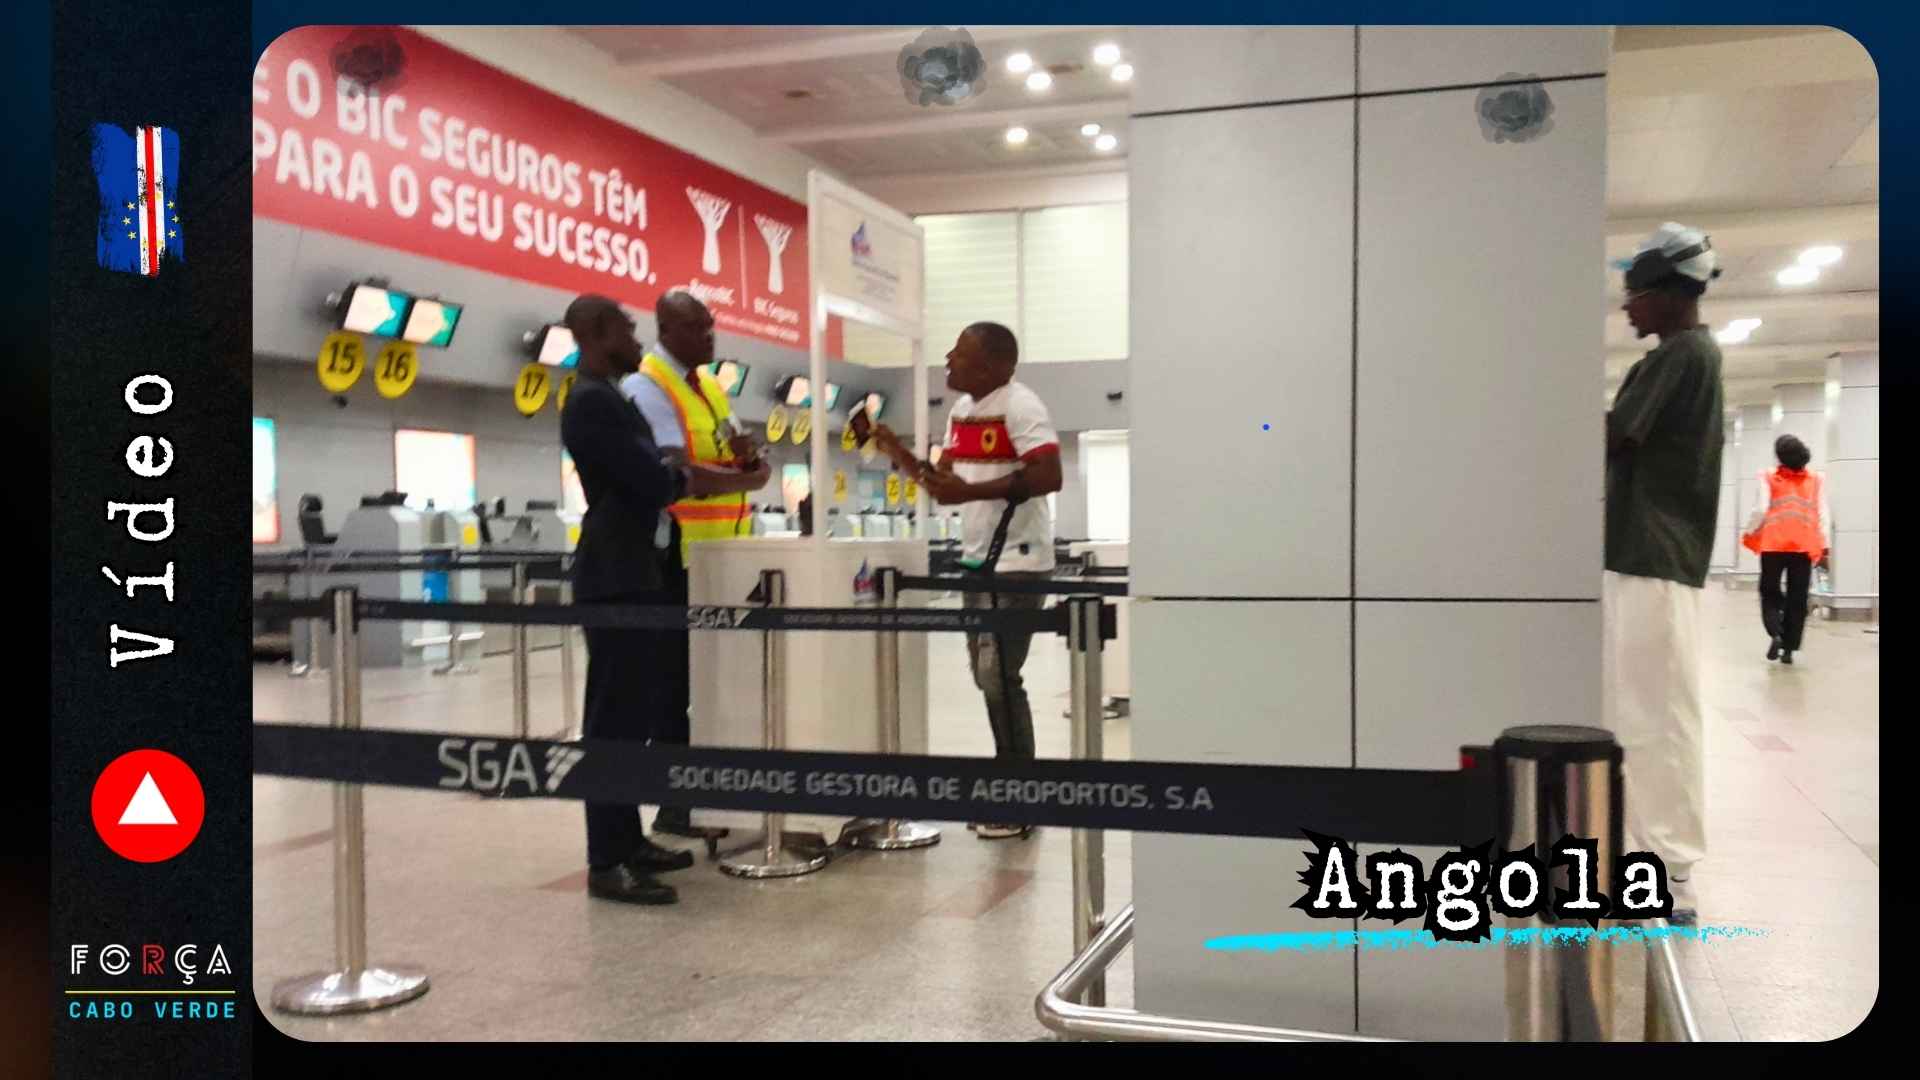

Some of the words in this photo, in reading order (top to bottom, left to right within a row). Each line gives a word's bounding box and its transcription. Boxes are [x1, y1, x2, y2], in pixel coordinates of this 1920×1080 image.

[286, 58, 321, 119] O
[336, 73, 408, 149] BIC
[418, 107, 583, 208] SEGUROS
[588, 168, 648, 231] TÊM
[253, 116, 379, 209] PARA
[389, 164, 420, 218] O
[430, 176, 504, 242] SEU
[512, 201, 657, 285] SUCESSO.
[328, 340, 358, 374] 15
[382, 350, 411, 383] 16
[521, 371, 545, 399] 17
[438, 738, 538, 793] SGA
[668, 765, 797, 794] SOCIEDADE
[805, 771, 918, 798] GESTORA
[927, 776, 960, 800] DE
